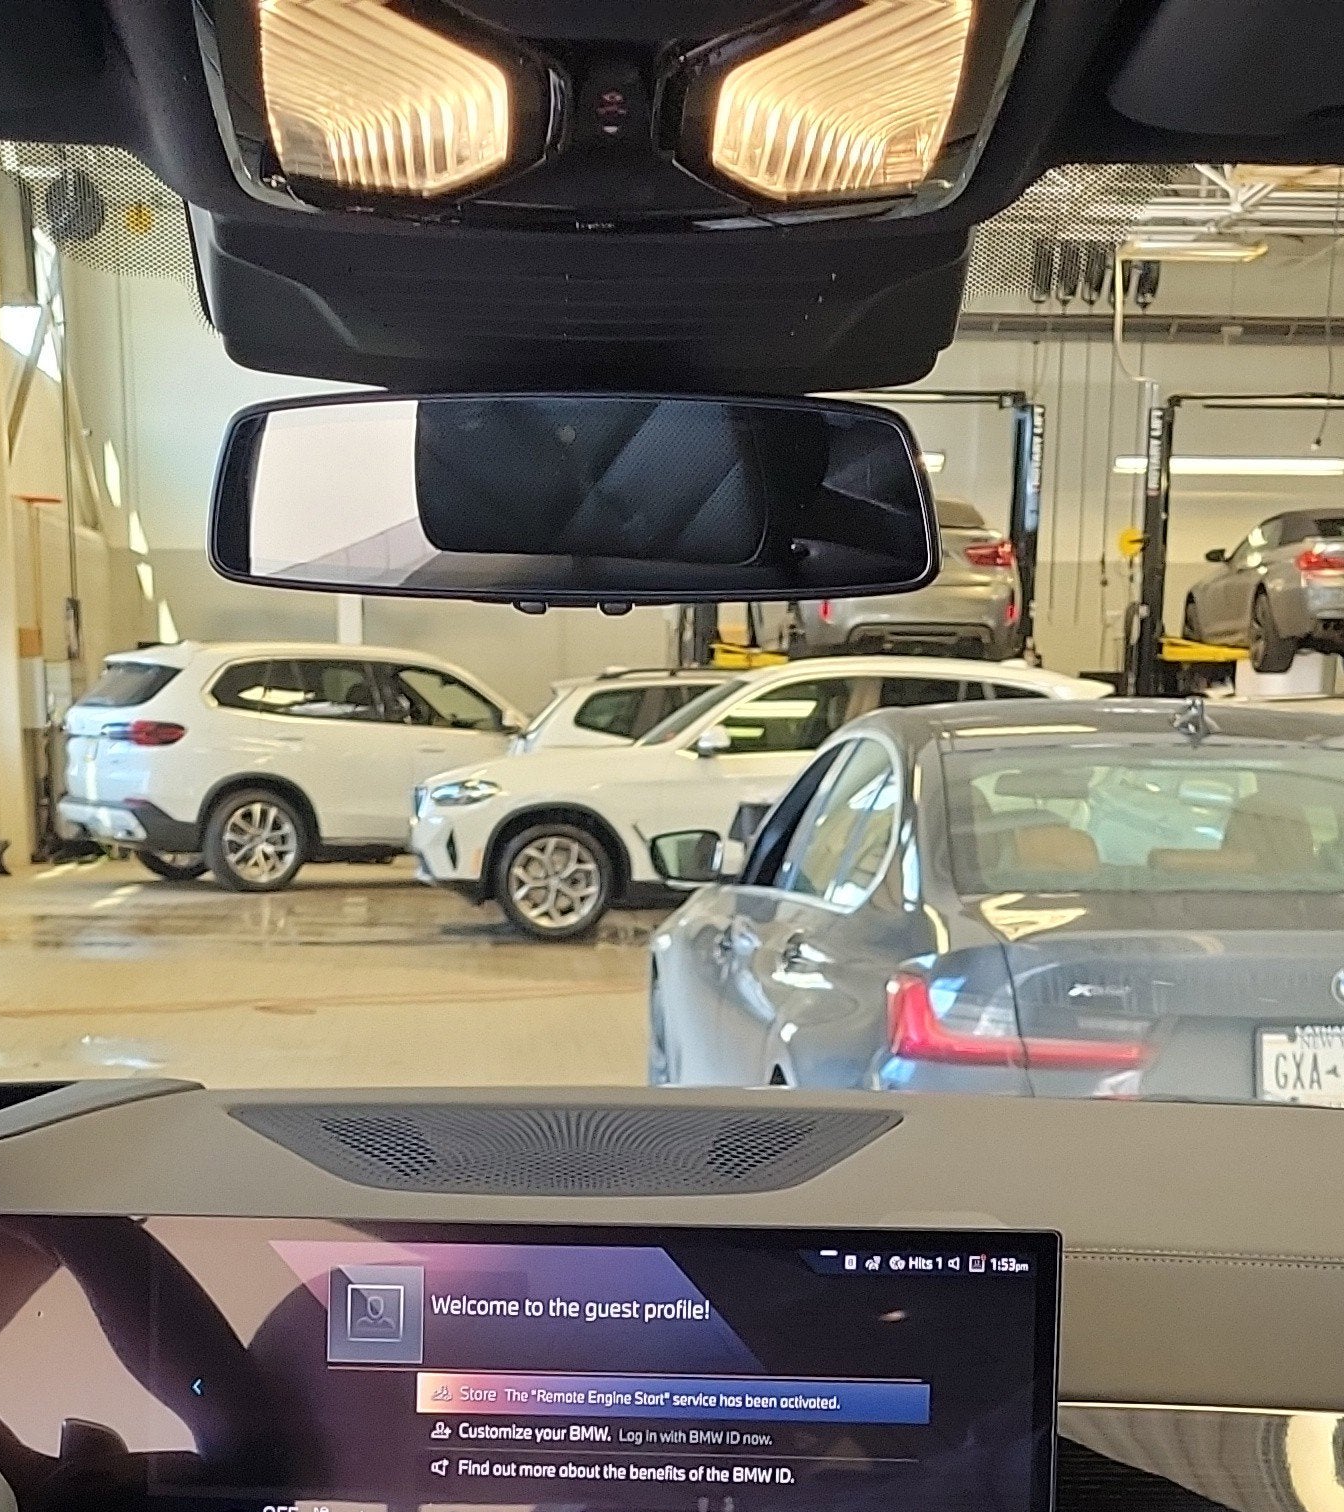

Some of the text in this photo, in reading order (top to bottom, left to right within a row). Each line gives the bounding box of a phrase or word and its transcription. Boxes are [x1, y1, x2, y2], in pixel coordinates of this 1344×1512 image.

[431, 1294, 710, 1323] Welcome to the guest profile!
[459, 1385, 498, 1402] Store
[504, 1388, 529, 1403] The
[588, 1390, 632, 1407] Engine
[672, 1392, 717, 1408] service
[719, 1393, 743, 1408] has
[745, 1394, 778, 1409] been
[780, 1395, 841, 1410] activated.
[458, 1422, 773, 1446] Customize your BMW. Log in with BMW ID now.
[458, 1459, 795, 1484] Find out more about the benefits of the BMW ID.
